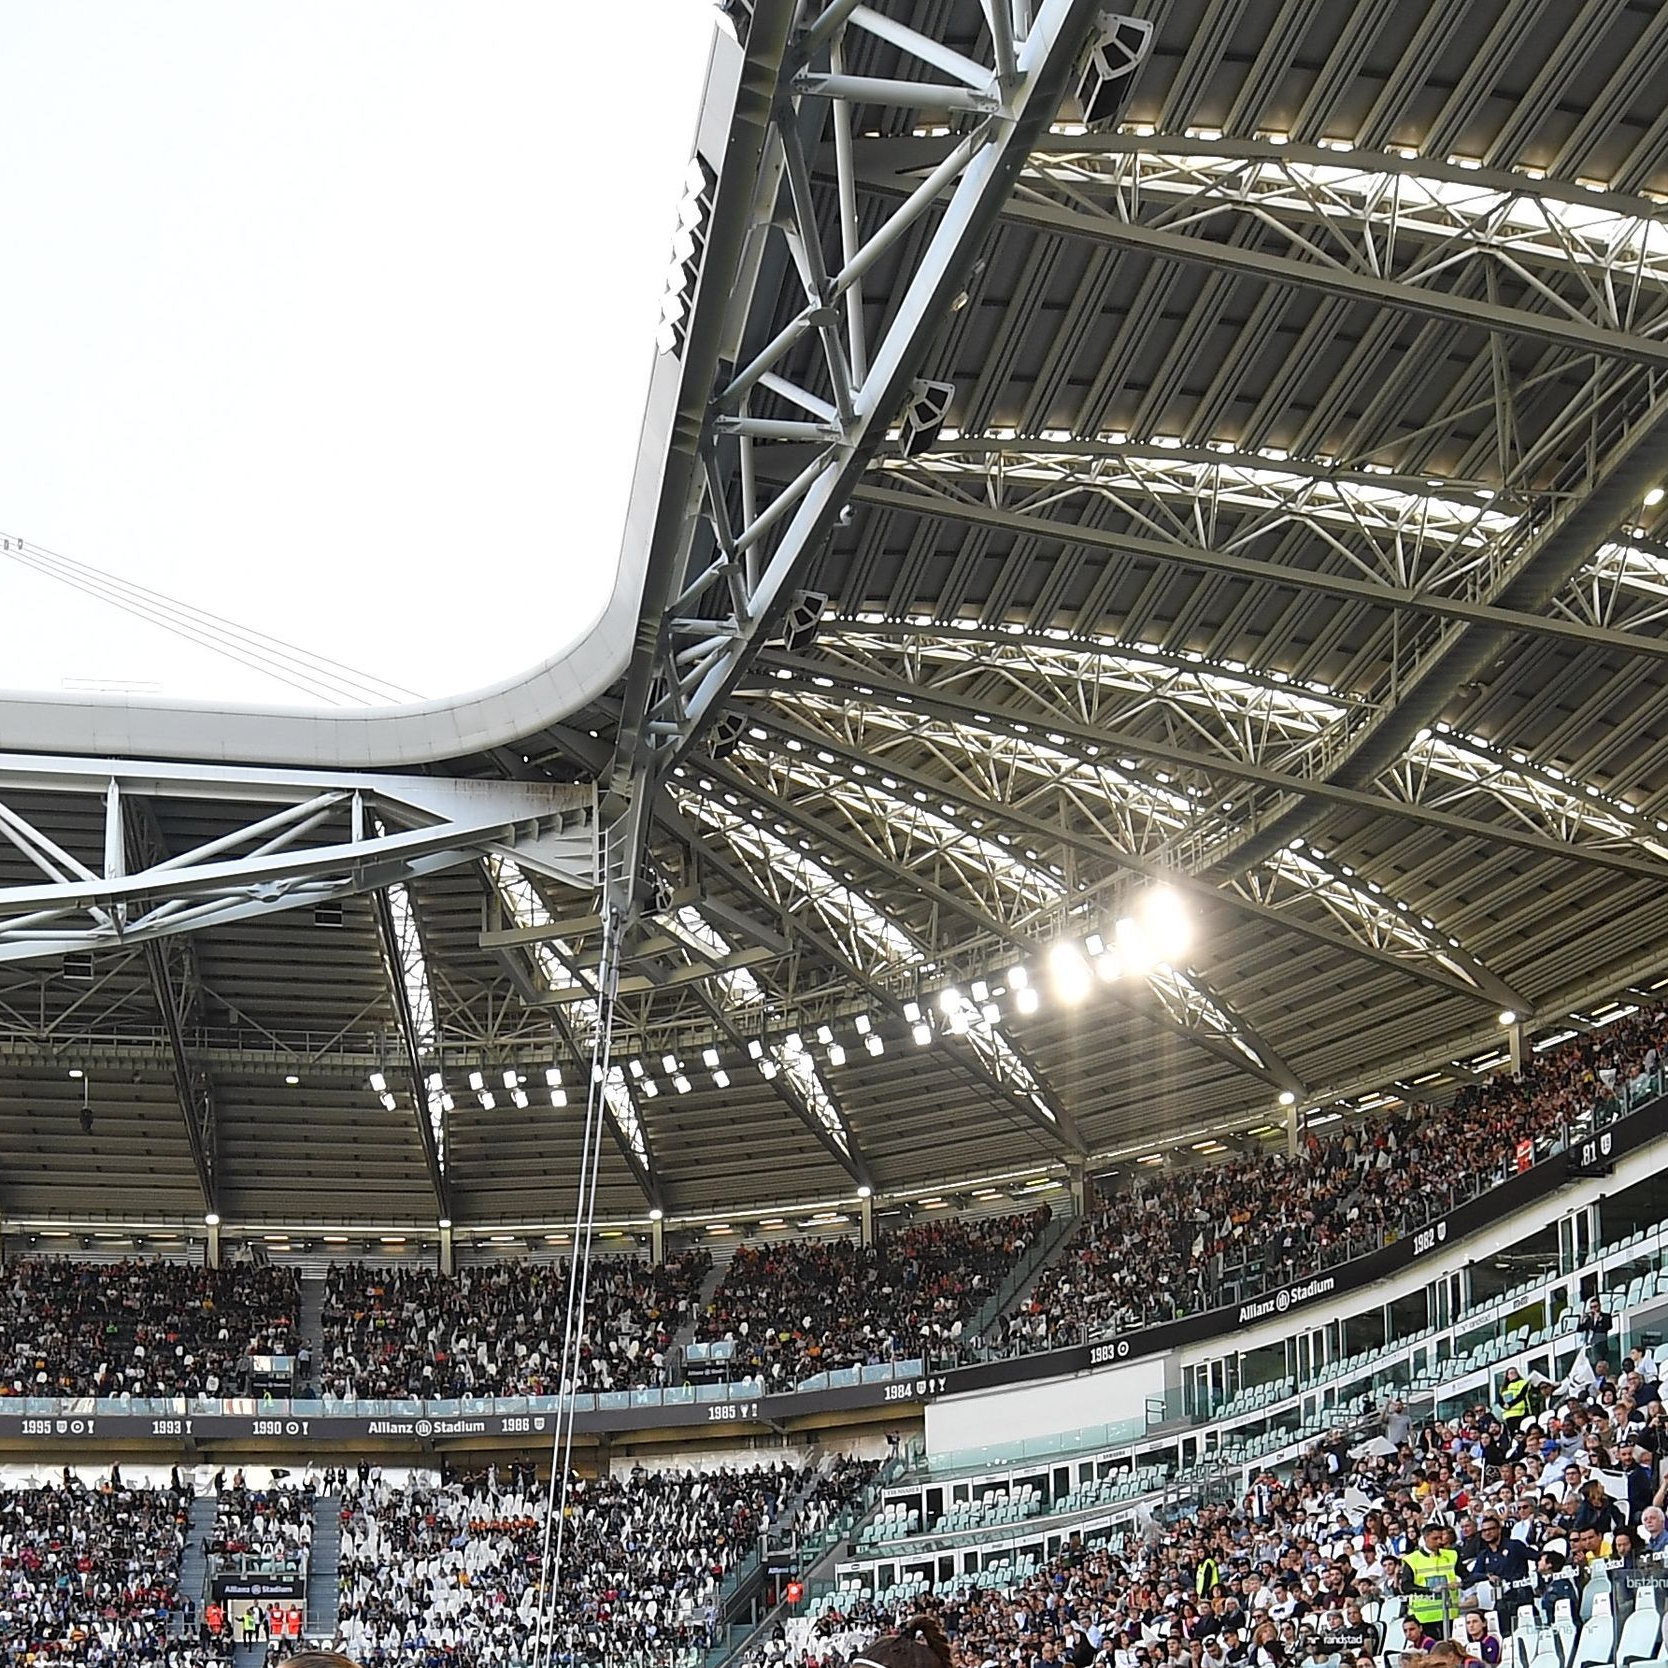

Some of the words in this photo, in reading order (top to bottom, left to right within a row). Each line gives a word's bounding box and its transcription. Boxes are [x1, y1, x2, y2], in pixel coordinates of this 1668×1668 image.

[1413, 1228, 1435, 1256] 1982
[1239, 1299, 1275, 1323] Allianz
[1291, 1277, 1334, 1304] Stadium
[1090, 1347, 1115, 1364] 1983
[884, 1385, 913, 1400] 1984
[708, 1405, 736, 1420] 1985
[22, 1420, 51, 1434] 1995
[152, 1420, 182, 1434] 1993
[253, 1420, 282, 1435] 1990
[368, 1421, 413, 1434] Allianz
[434, 1420, 485, 1434] Stadium
[501, 1418, 529, 1432] 1986
[1323, 1633, 1363, 1645] randstad
